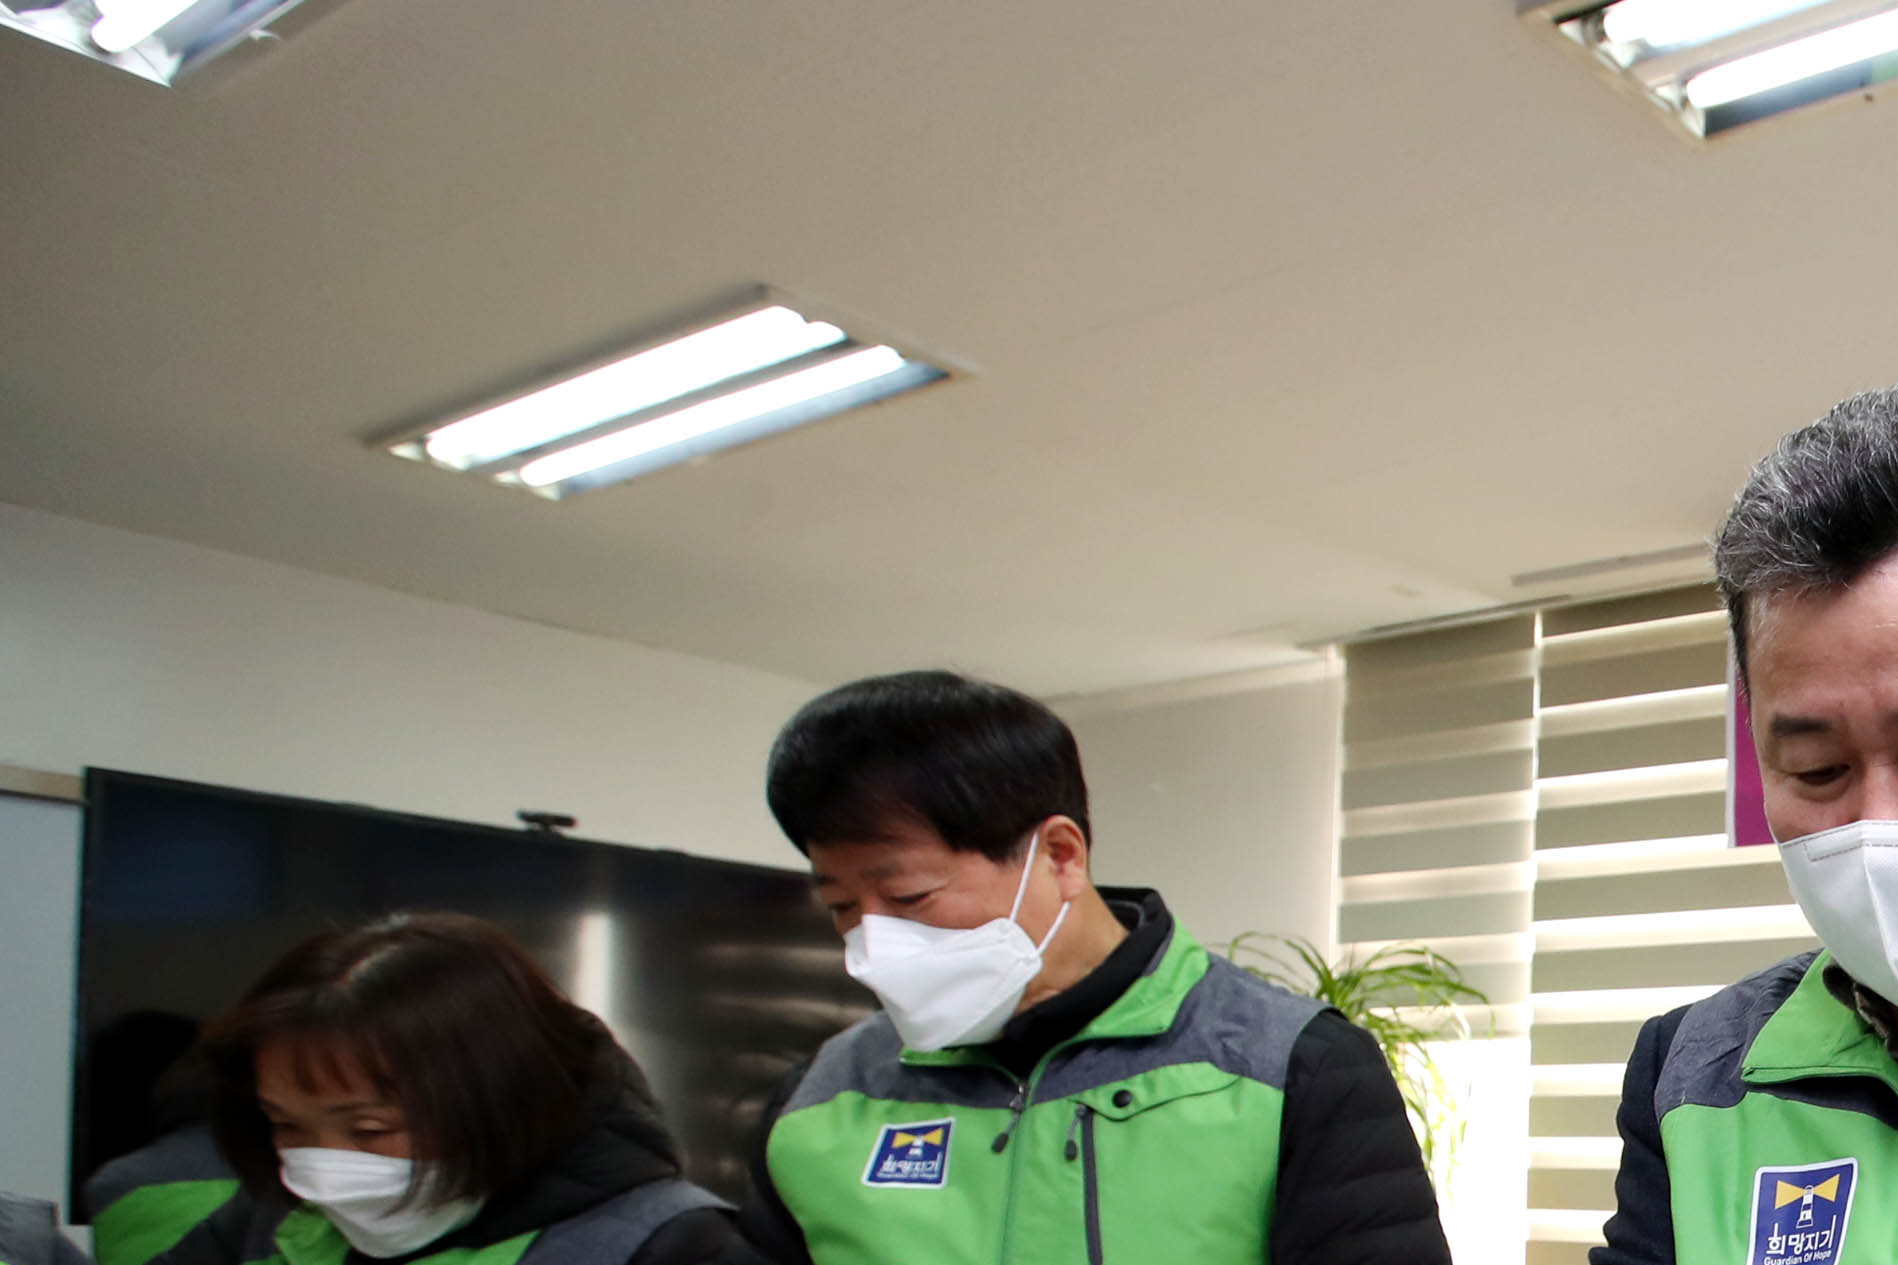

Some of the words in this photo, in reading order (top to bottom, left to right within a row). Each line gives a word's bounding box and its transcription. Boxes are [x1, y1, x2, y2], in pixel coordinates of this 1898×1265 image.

[1765, 1214, 1837, 1256] 희망지기
[1804, 1254, 1813, 1263] Of
[1813, 1249, 1832, 1260] Hope
